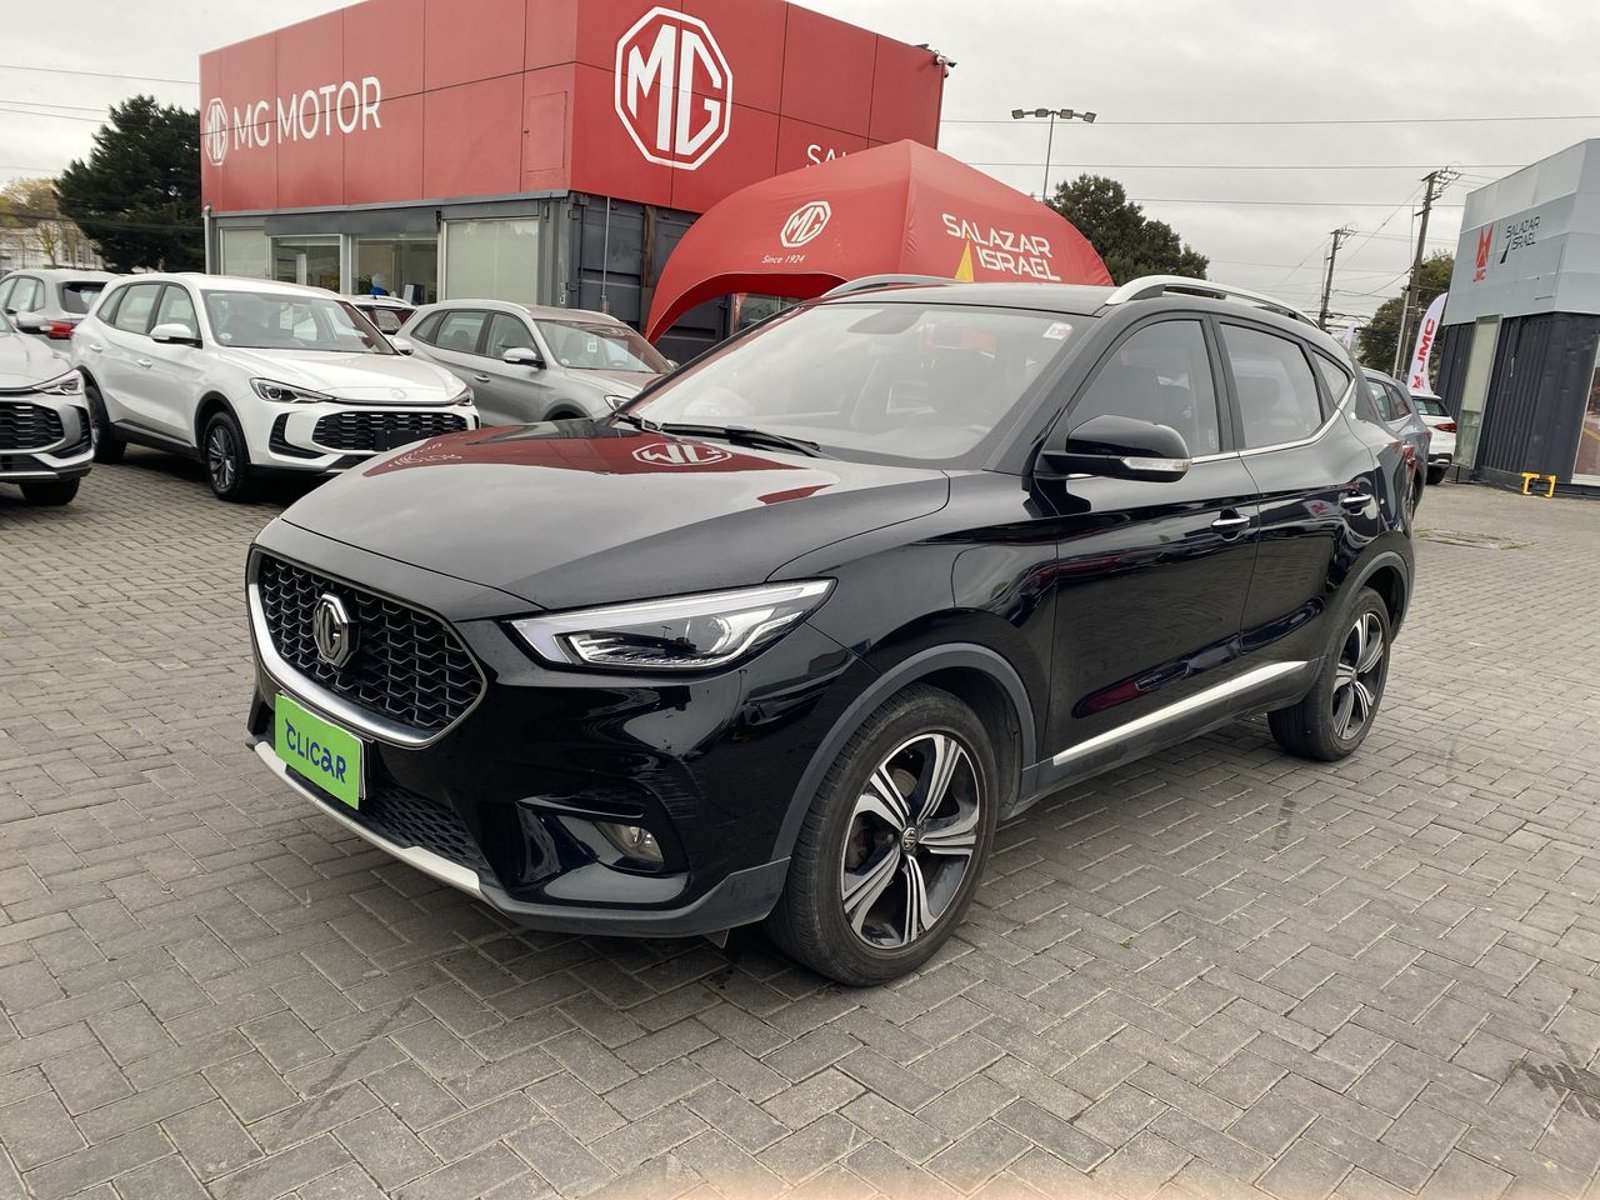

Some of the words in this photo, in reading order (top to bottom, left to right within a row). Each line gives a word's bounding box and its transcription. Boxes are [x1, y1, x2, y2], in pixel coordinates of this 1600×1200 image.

[233, 100, 270, 151] MG
[276, 76, 382, 144] MOTOR
[627, 22, 723, 157] MG
[206, 102, 226, 161] MG
[786, 205, 826, 243] MG
[941, 213, 1053, 259] SALAZAR
[1505, 215, 1541, 239] SALAZAR
[975, 245, 1062, 282] ISRAEL
[1417, 318, 1436, 373] JMC
